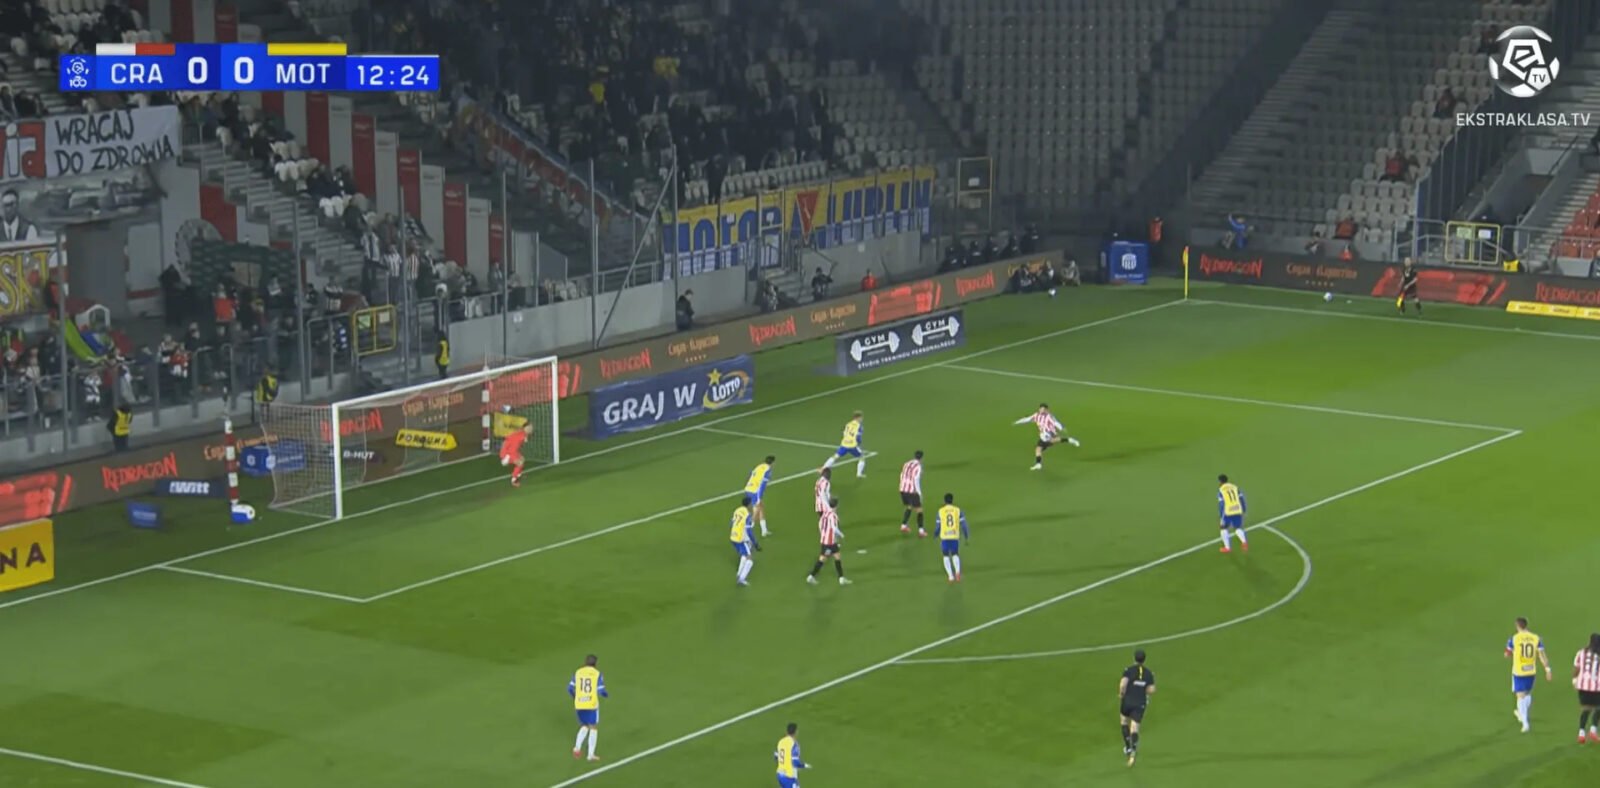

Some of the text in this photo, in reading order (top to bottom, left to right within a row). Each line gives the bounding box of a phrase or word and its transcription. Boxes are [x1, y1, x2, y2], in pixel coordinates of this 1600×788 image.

[55, 109, 134, 146] WRACAJ
[55, 134, 174, 175] DO ZDROWIA
[1200, 253, 1263, 279] REDRAGON
[925, 319, 945, 331] GYM
[865, 334, 885, 346] GYM
[603, 377, 741, 425] GRAJ W LOTTO
[101, 450, 178, 493] REDRAGON
[1226, 489, 1236, 502] 11
[946, 513, 954, 528] 8
[1520, 643, 1534, 659] 10
[579, 677, 592, 694] 18
[779, 748, 785, 764] 9
